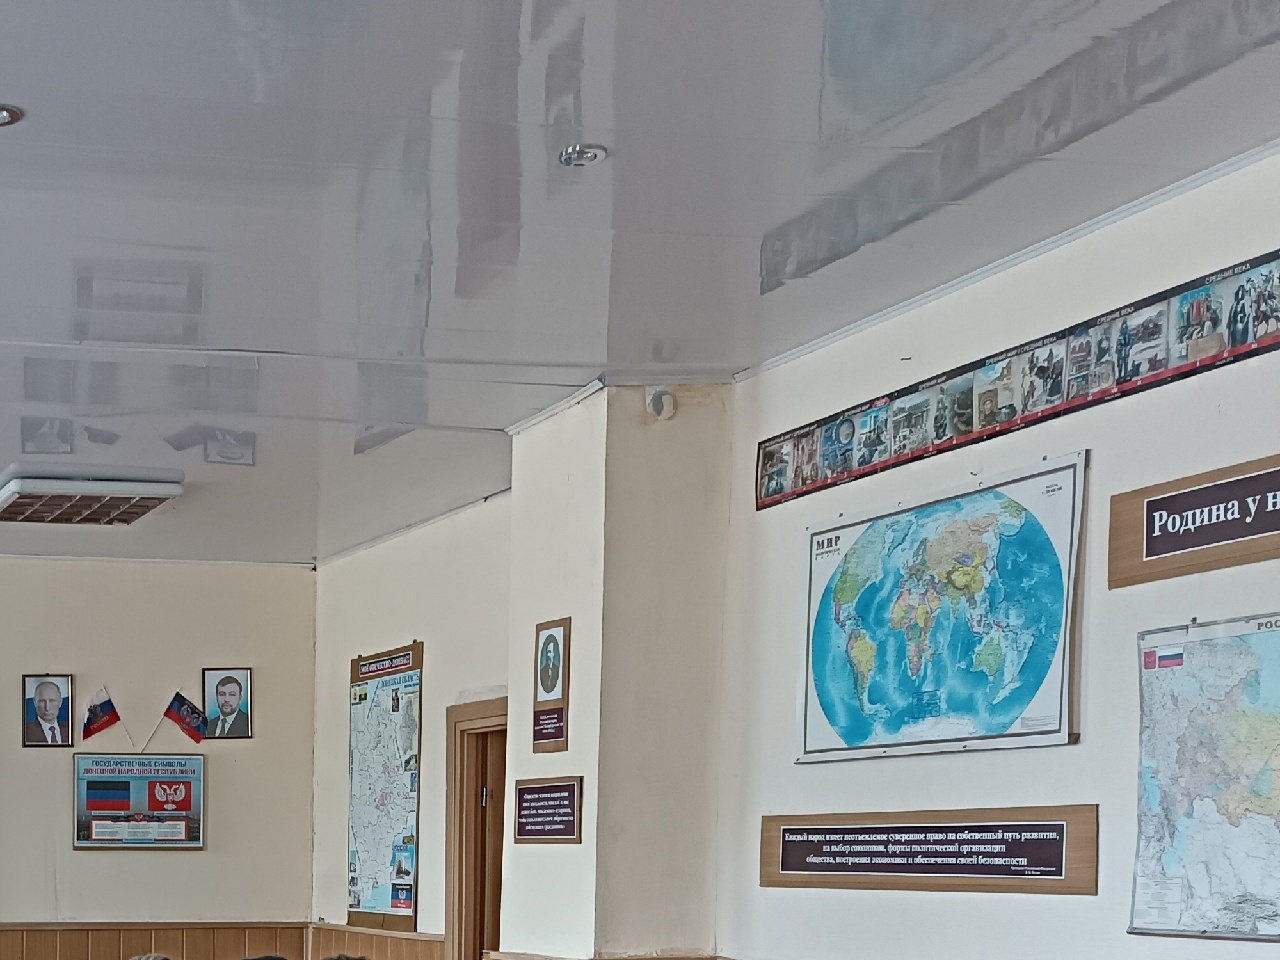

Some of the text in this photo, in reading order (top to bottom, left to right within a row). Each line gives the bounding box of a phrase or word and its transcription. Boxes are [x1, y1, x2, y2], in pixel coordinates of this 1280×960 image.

[1234, 263, 1251, 274] ВЕКА
[1152, 499, 1240, 537] Родина
[1245, 494, 1261, 523] у
[816, 535, 841, 550] МИР
[91, 760, 152, 768] ГОСУДАРСТВЕННЫЕ
[926, 832, 946, 842] право
[947, 832, 956, 840] на
[957, 830, 1003, 840] собственный
[1004, 832, 1020, 842] путь
